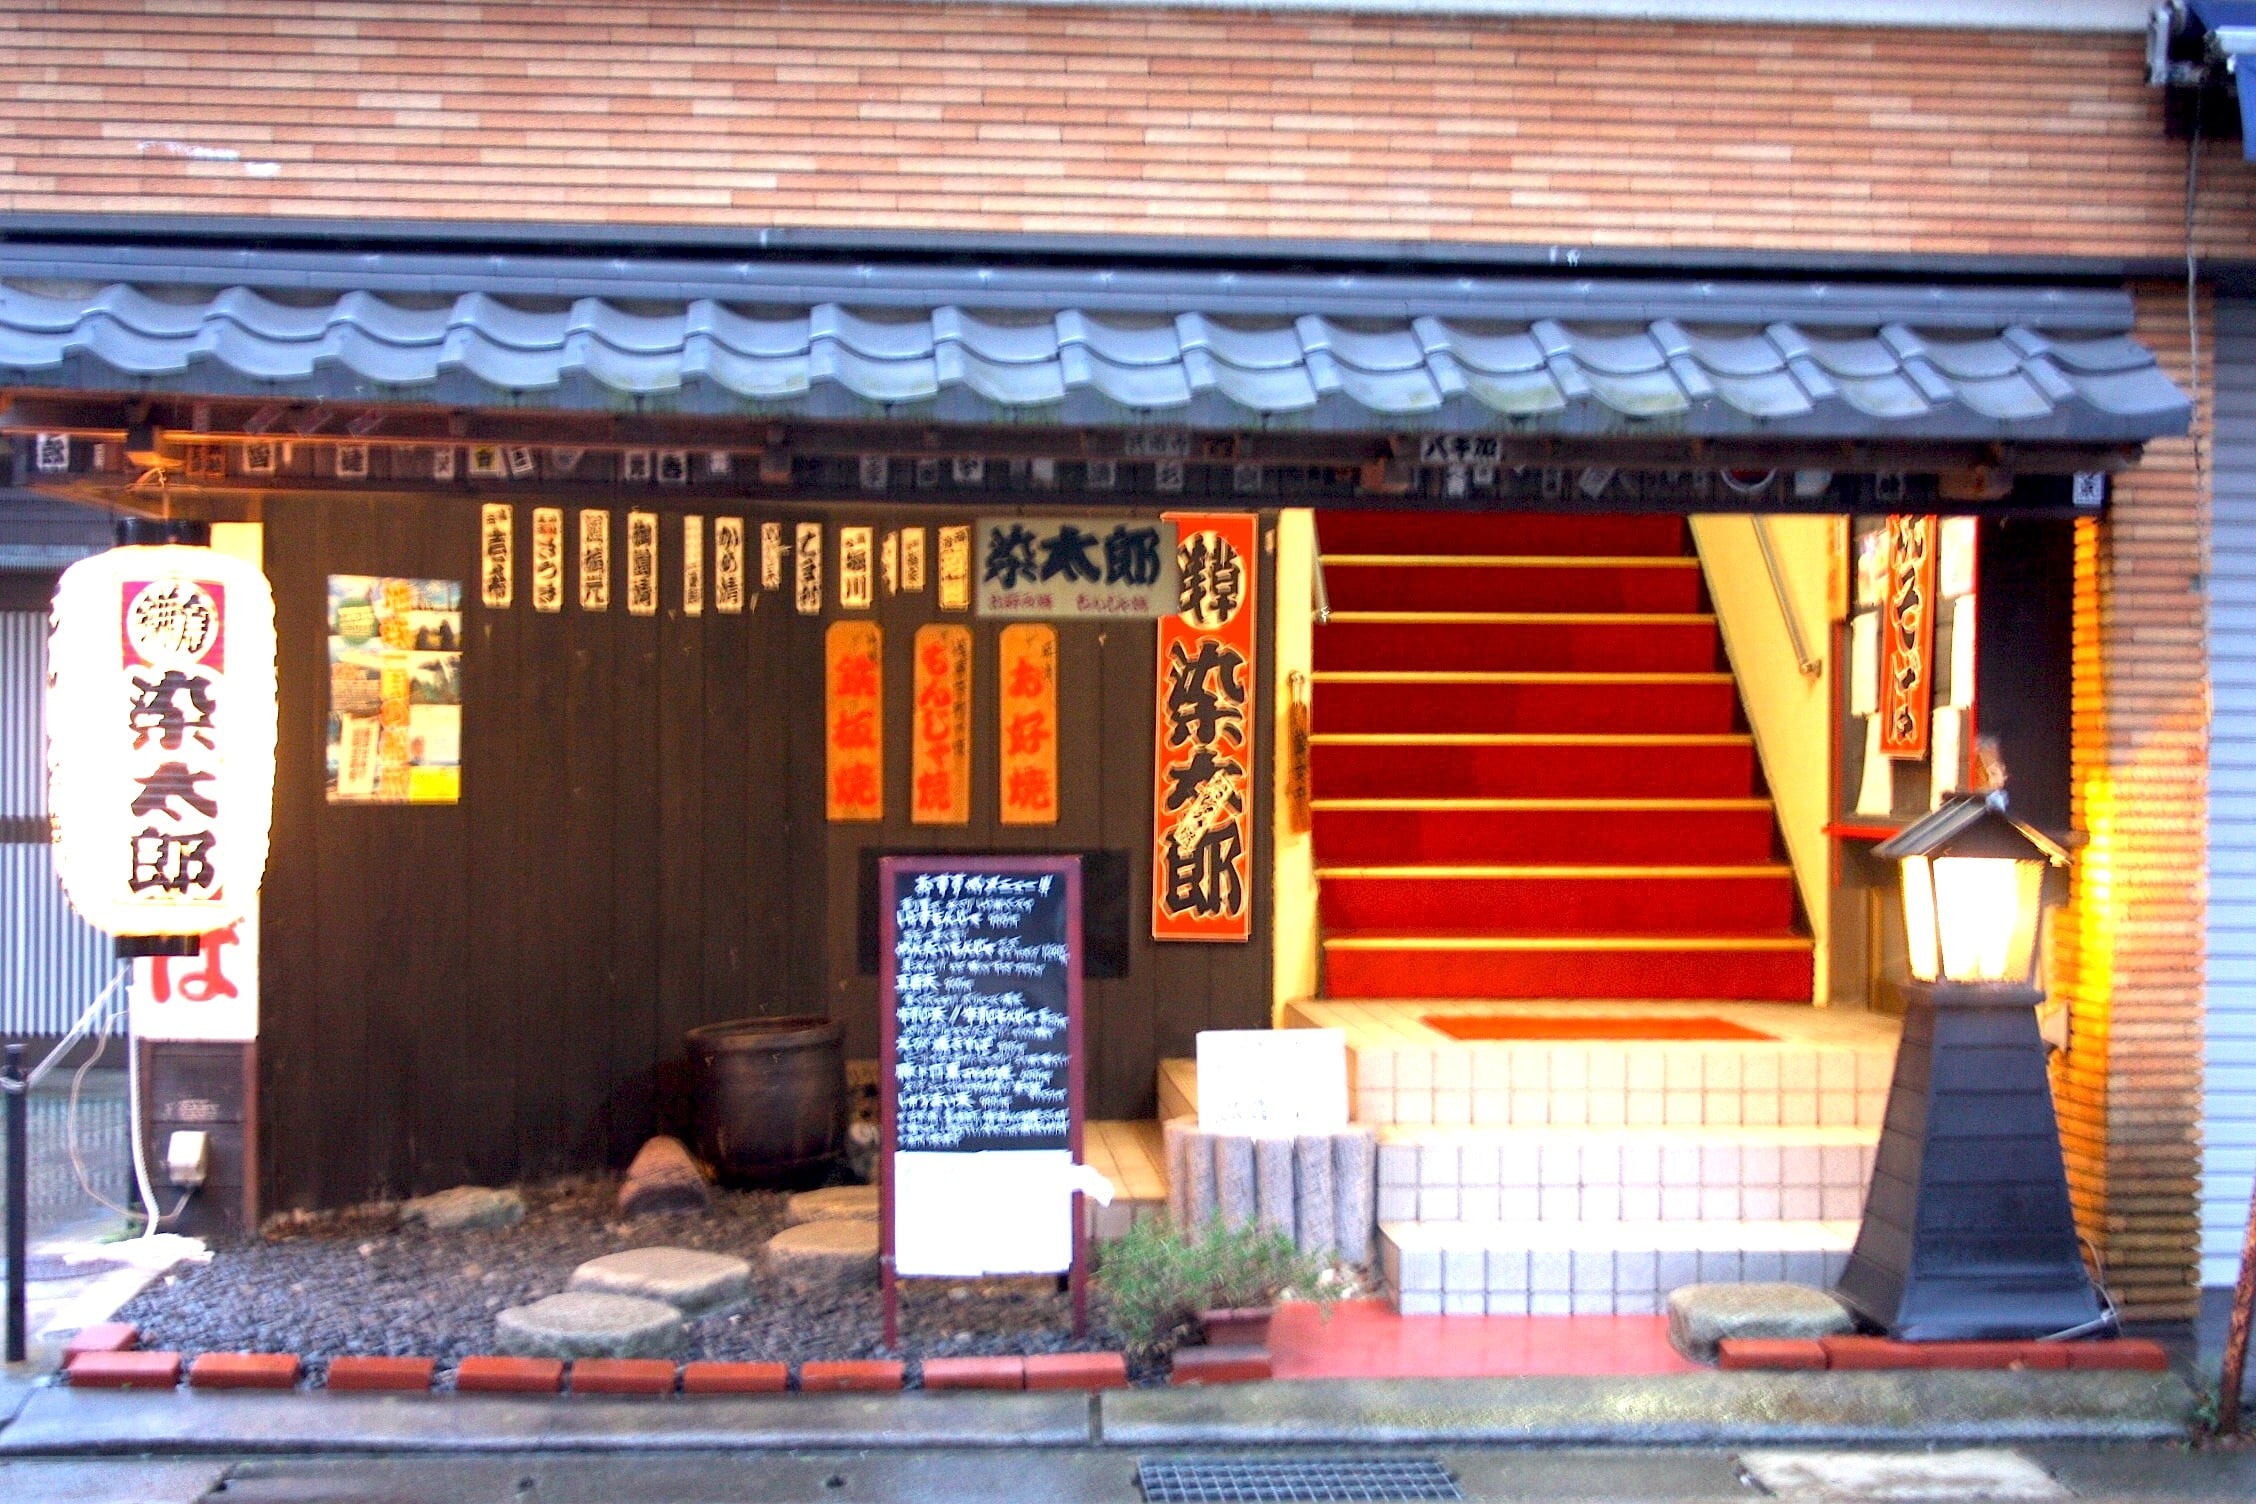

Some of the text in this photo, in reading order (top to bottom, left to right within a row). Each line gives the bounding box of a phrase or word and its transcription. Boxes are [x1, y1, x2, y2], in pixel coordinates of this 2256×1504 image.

[983, 522, 1161, 591] 染太郎
[128, 669, 219, 894] 染太郎
[1165, 639, 1244, 918] 染太郎
